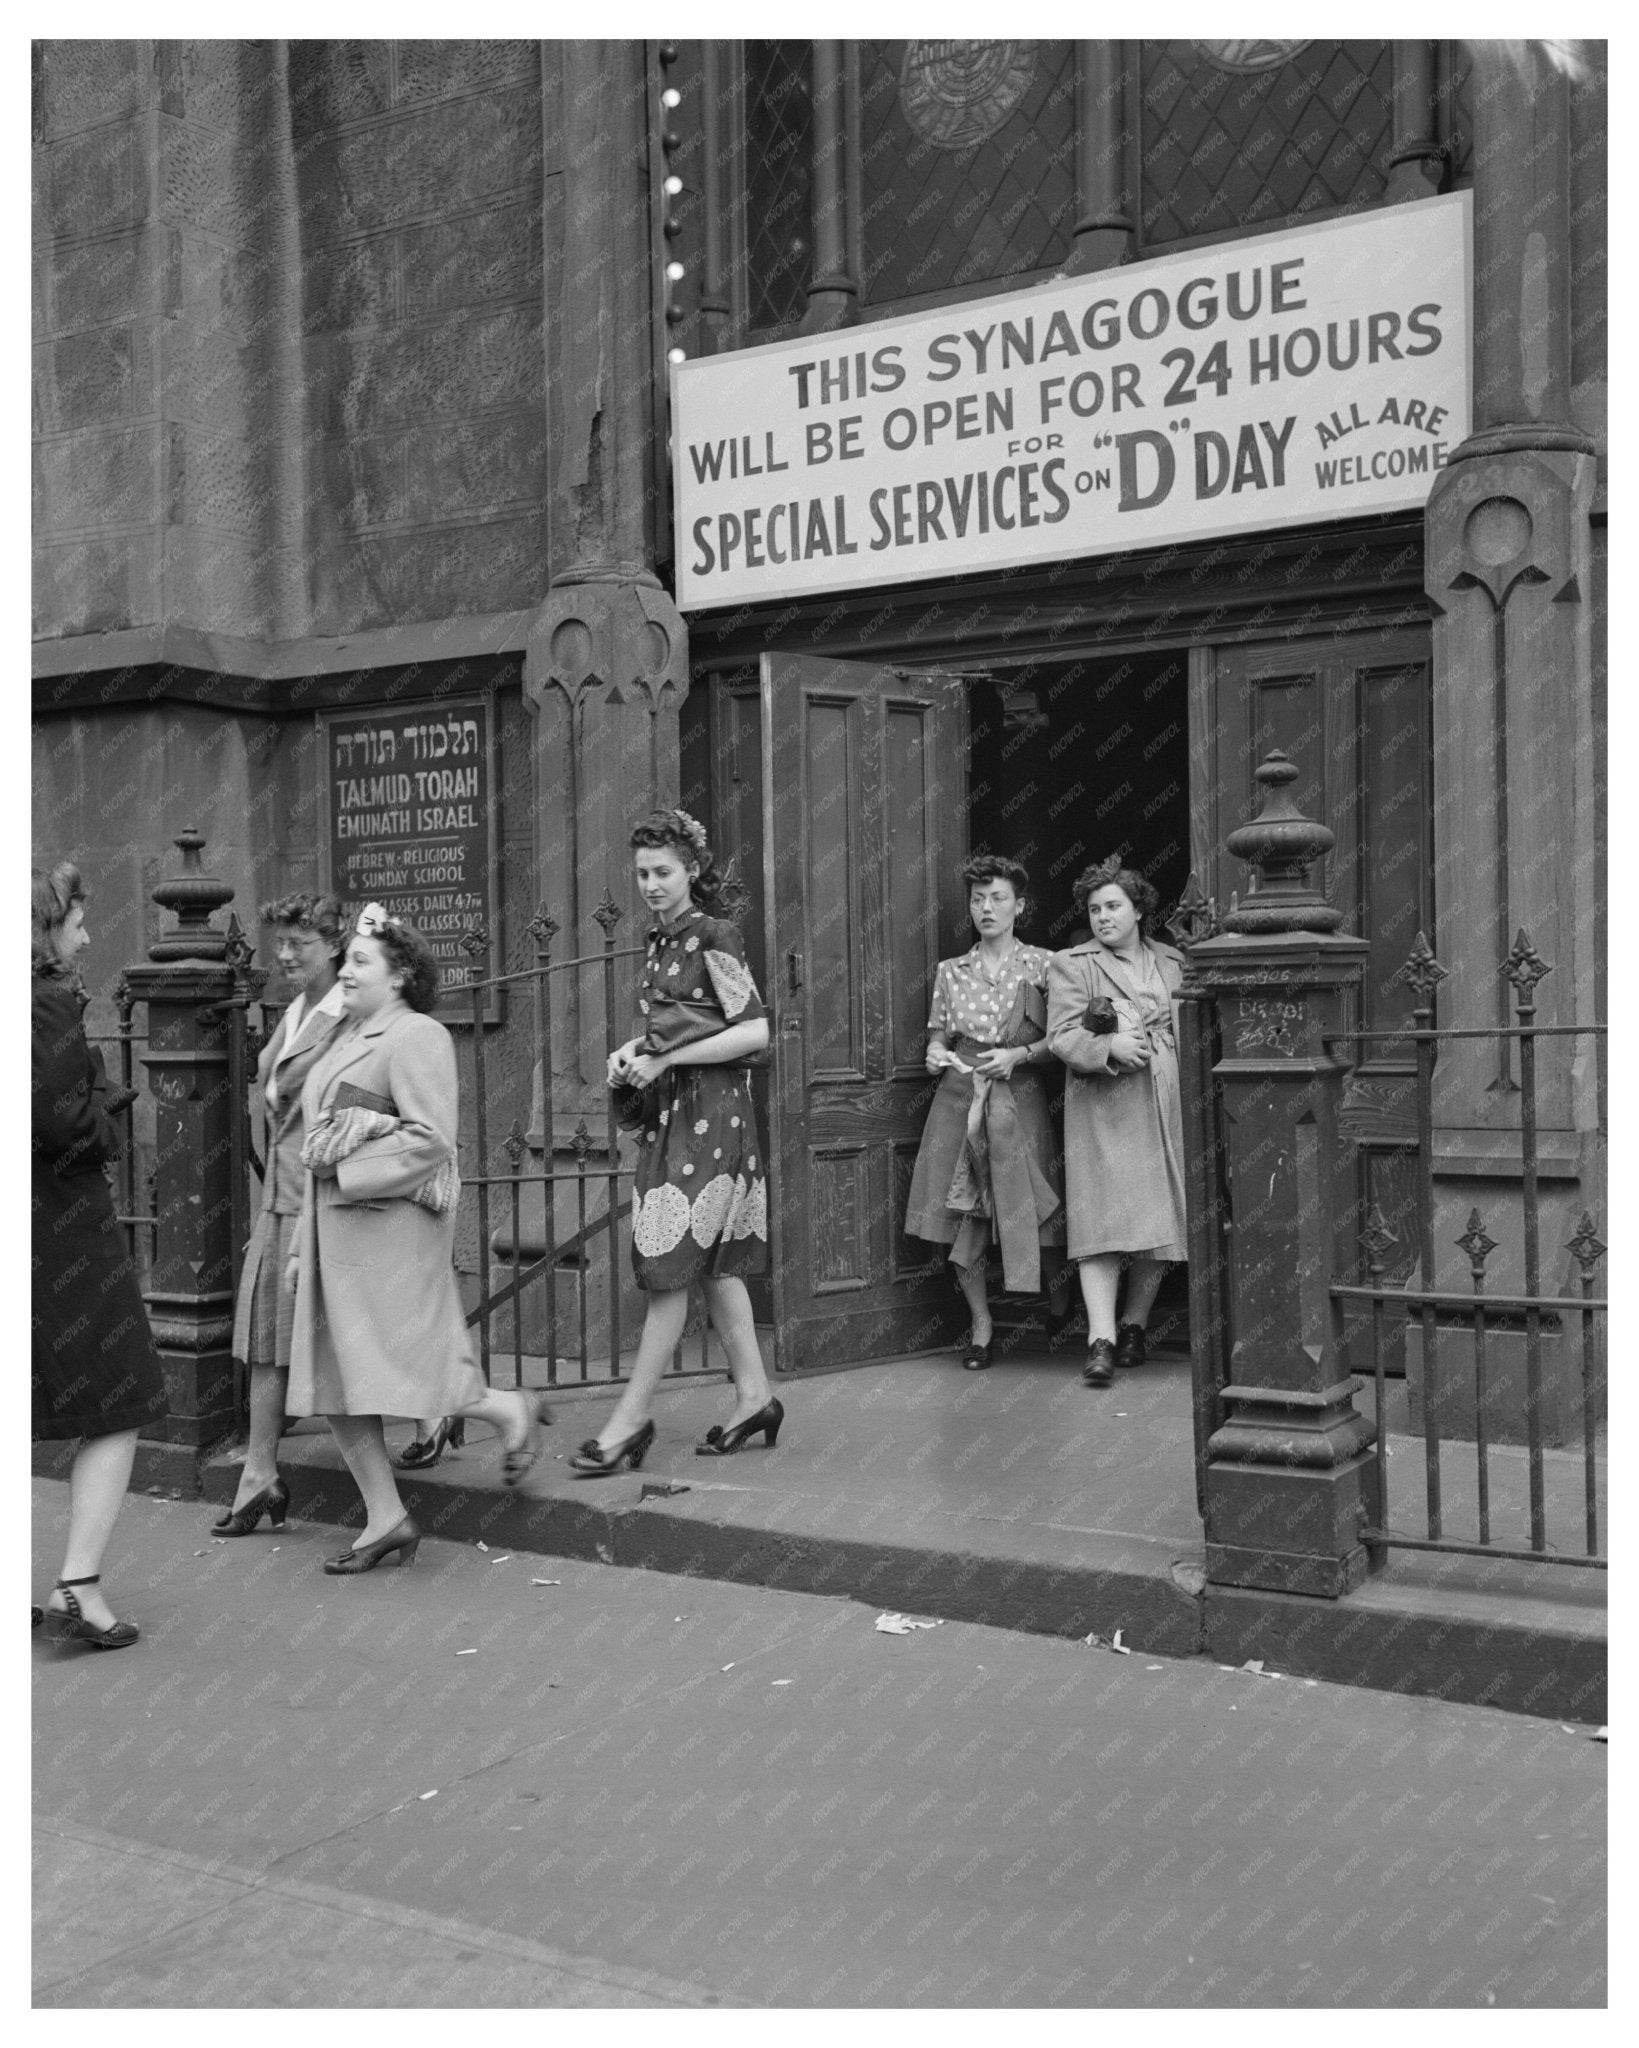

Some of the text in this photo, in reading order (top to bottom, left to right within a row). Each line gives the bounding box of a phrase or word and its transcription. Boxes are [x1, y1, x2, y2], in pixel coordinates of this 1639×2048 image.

[788, 257, 1307, 410] THIS SYNAGOGUE
[688, 303, 1443, 485] WILL BE OPEN FOR 24 HOURS
[1007, 433, 1064, 458] FOR
[1314, 397, 1449, 451] ALL ARE
[1314, 441, 1449, 490] WELCOME
[691, 494, 858, 576] SPECIAL
[869, 457, 1070, 551] SERVICES
[1074, 468, 1111, 494] ON
[1193, 415, 1297, 501] DAY
[336, 712, 479, 769] תלמוד תורה
[336, 766, 479, 809] TALMUD TORAH
[337, 804, 479, 839] EMUNATH ISRAEL
[348, 865, 466, 889] & SUNDAY SCHOOL
[418, 913, 461, 931] CLASSES
[424, 893, 454, 911] DAILY
